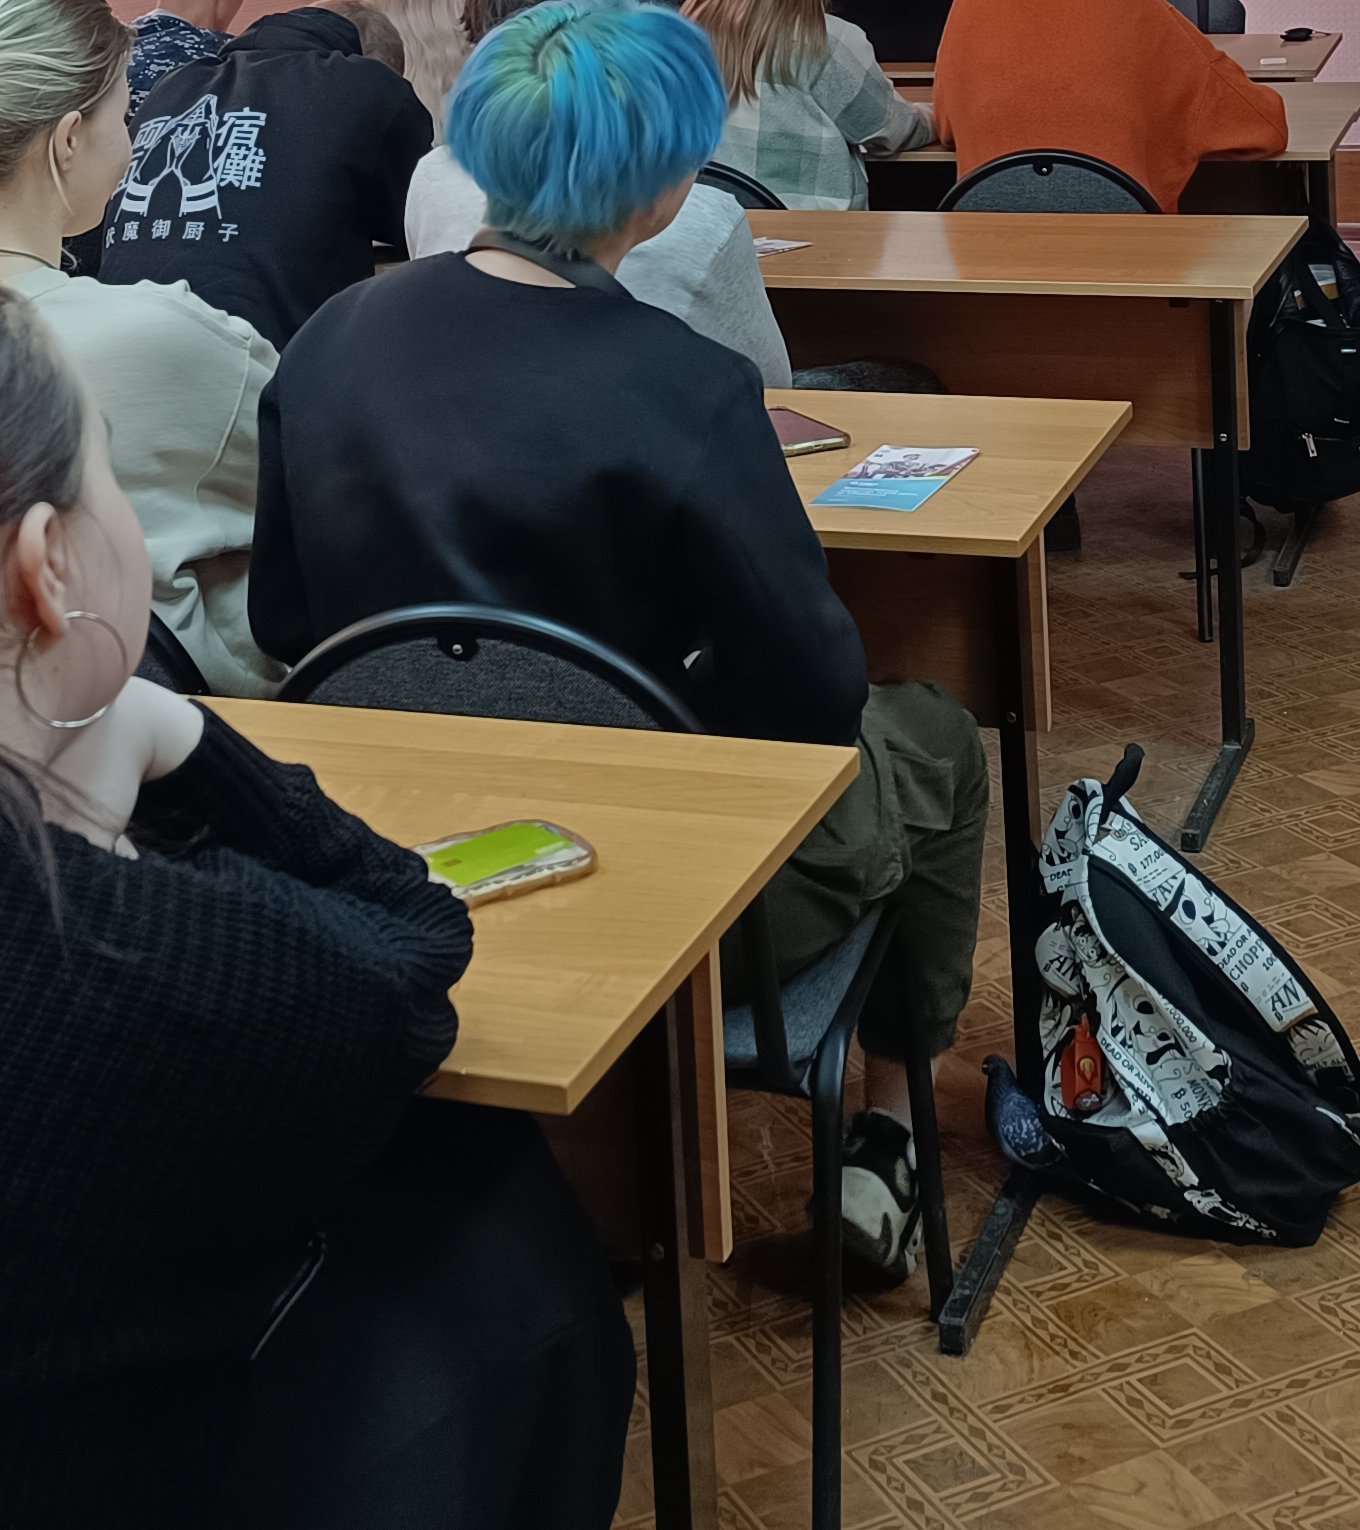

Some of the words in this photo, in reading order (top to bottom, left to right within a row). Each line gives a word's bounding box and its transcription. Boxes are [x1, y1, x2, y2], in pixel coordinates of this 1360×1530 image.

[1100, 1037, 1122, 1061] DEAD
[1121, 1057, 1135, 1073] OR
[1134, 1071, 1156, 1093] ALIVE
